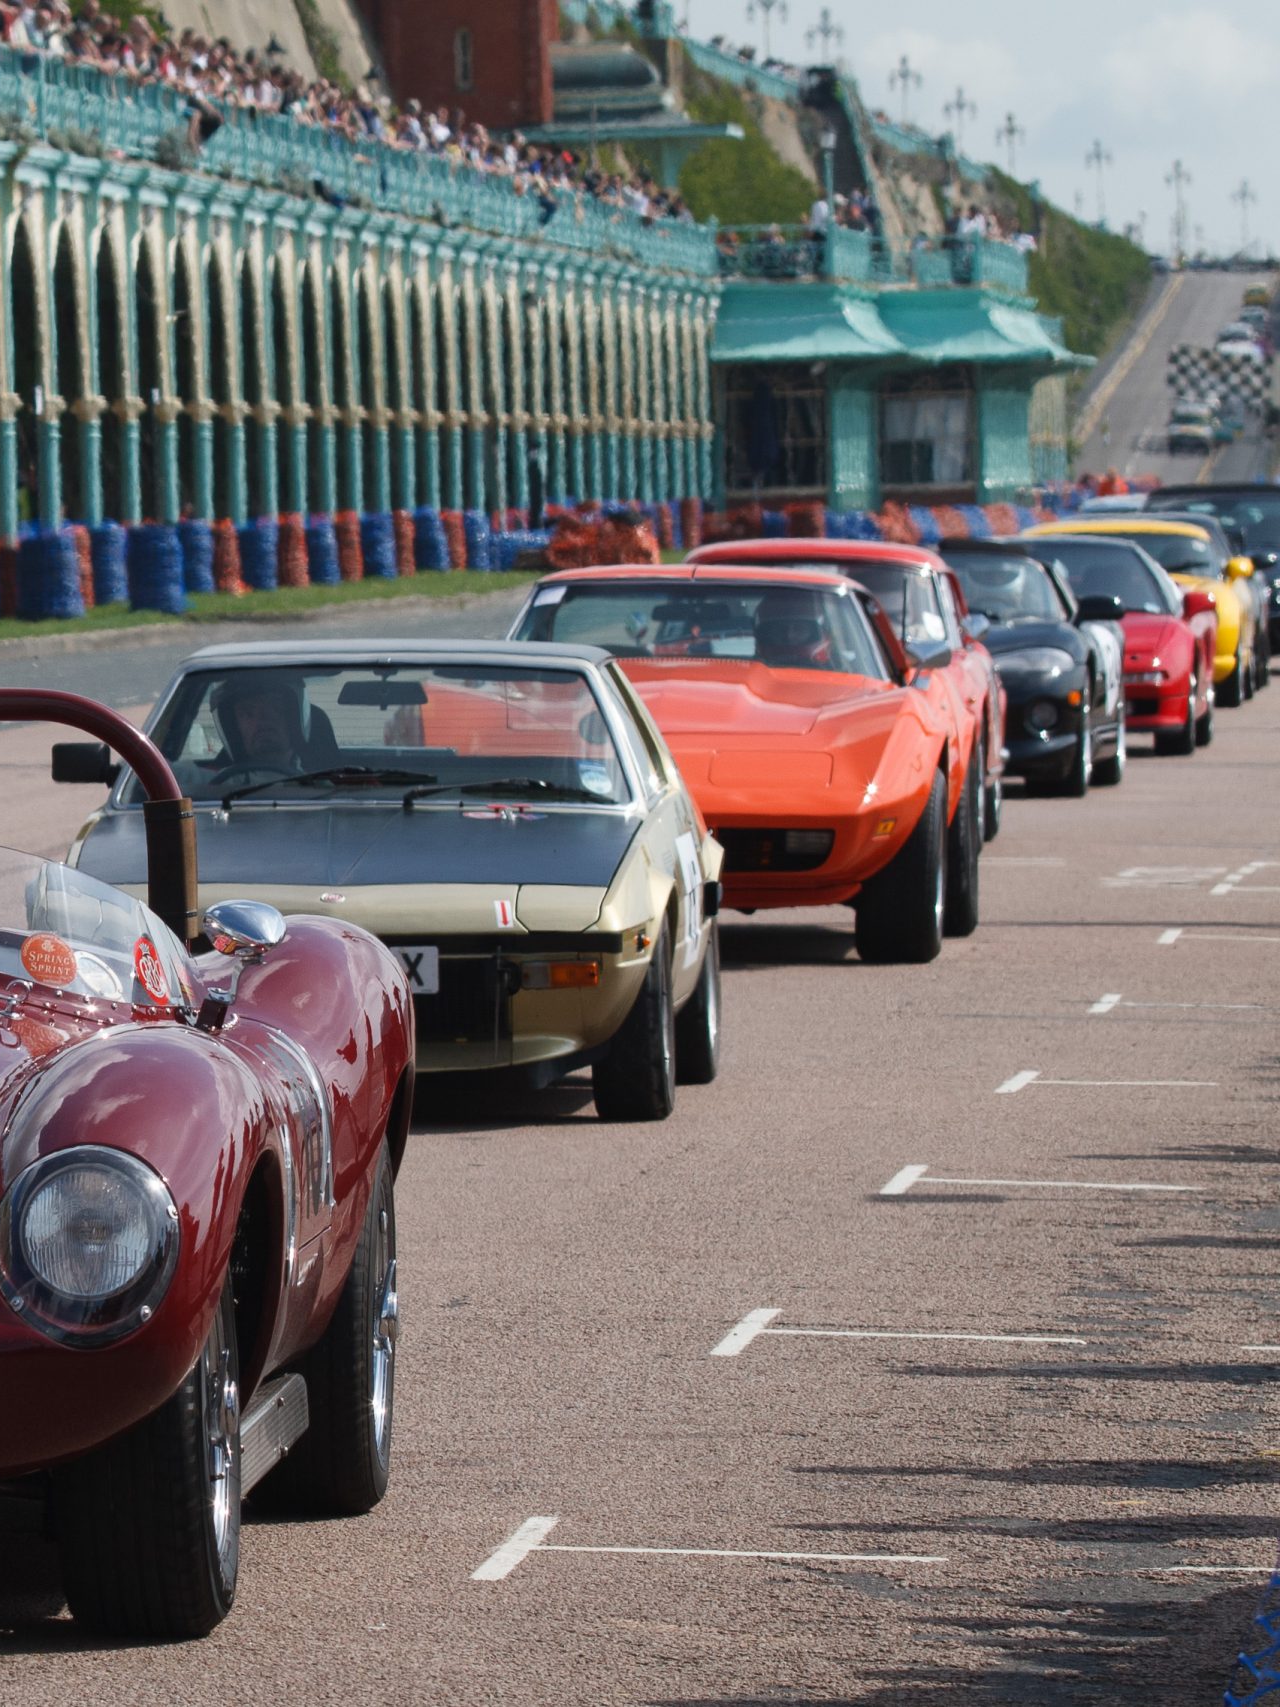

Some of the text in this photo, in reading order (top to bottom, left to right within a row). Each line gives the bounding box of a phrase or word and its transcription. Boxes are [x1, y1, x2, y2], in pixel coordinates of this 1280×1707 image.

[29, 951, 70, 965] SPRING
[30, 962, 70, 976] SPRINT
[402, 953, 424, 986] X
